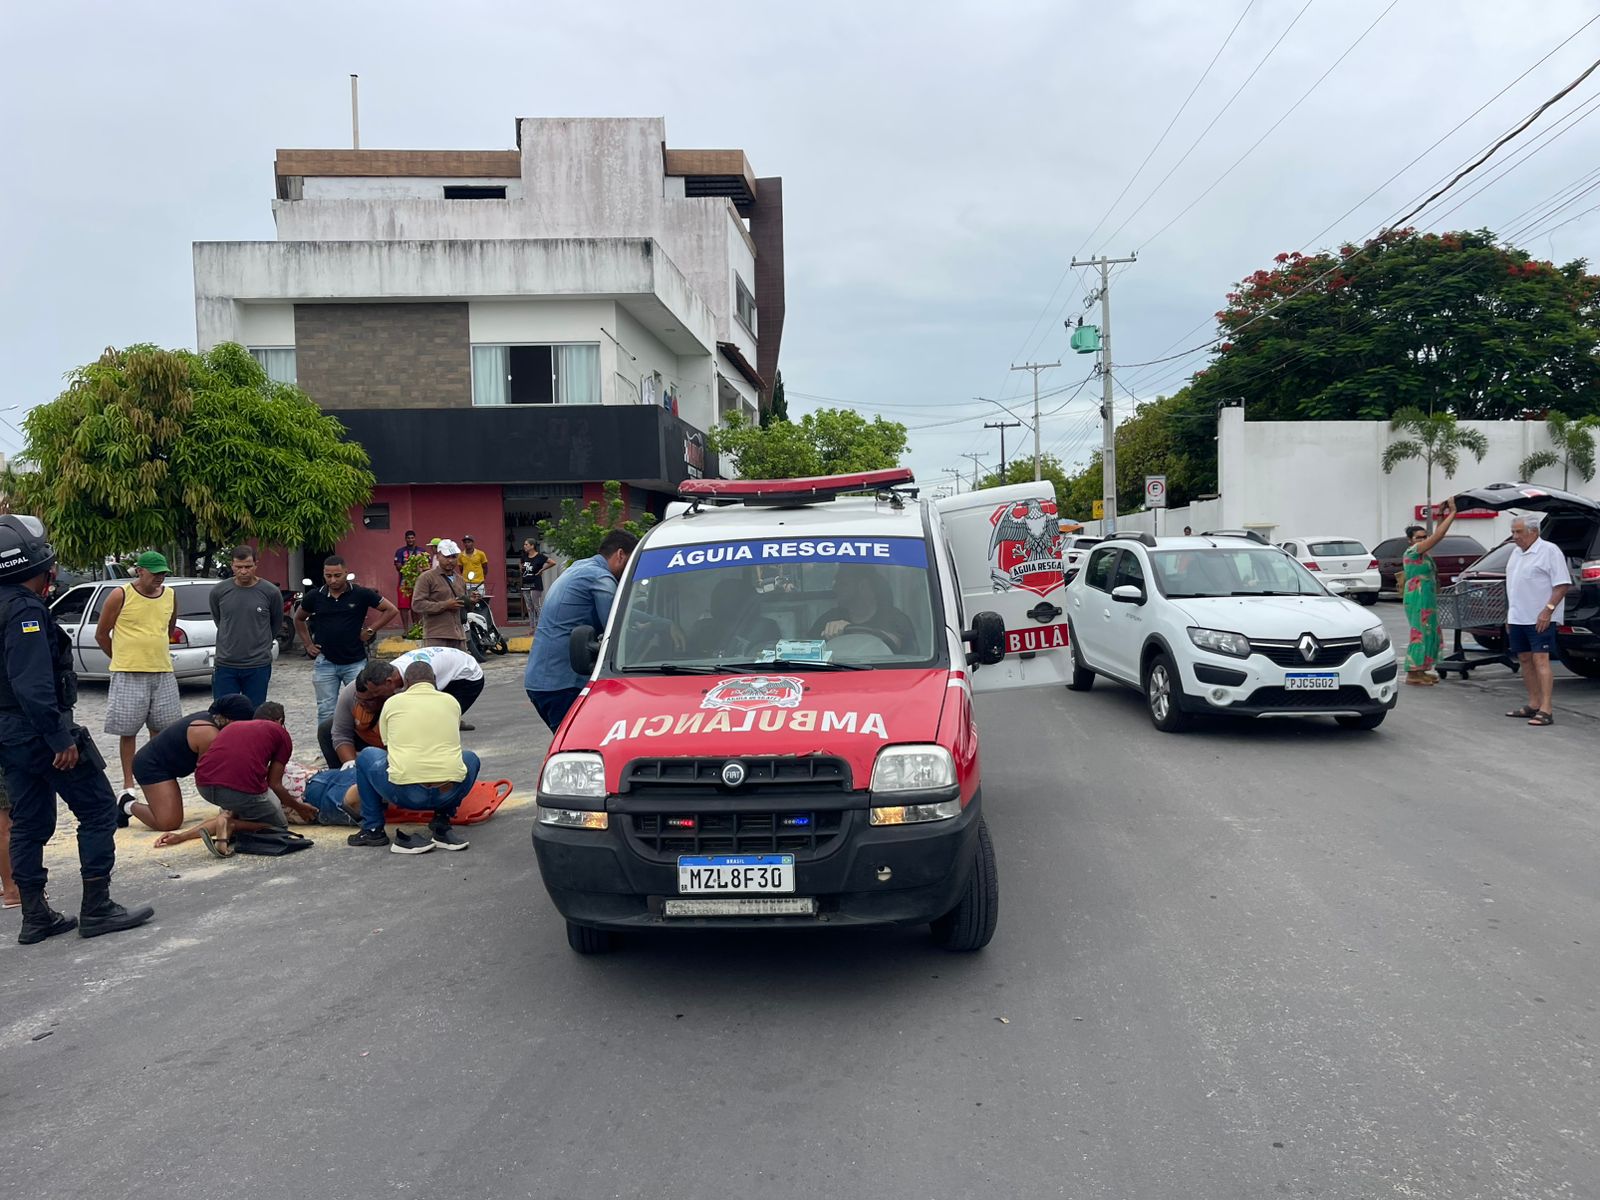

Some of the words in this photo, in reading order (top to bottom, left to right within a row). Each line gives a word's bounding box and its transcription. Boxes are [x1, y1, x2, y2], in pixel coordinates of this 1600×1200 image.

[667, 546, 752, 568] ÁGUIA
[762, 542, 890, 557] RESGATE
[1009, 625, 1064, 651] BULÂ
[725, 770, 740, 779] FIAT
[690, 867, 782, 889] MZL8F30
